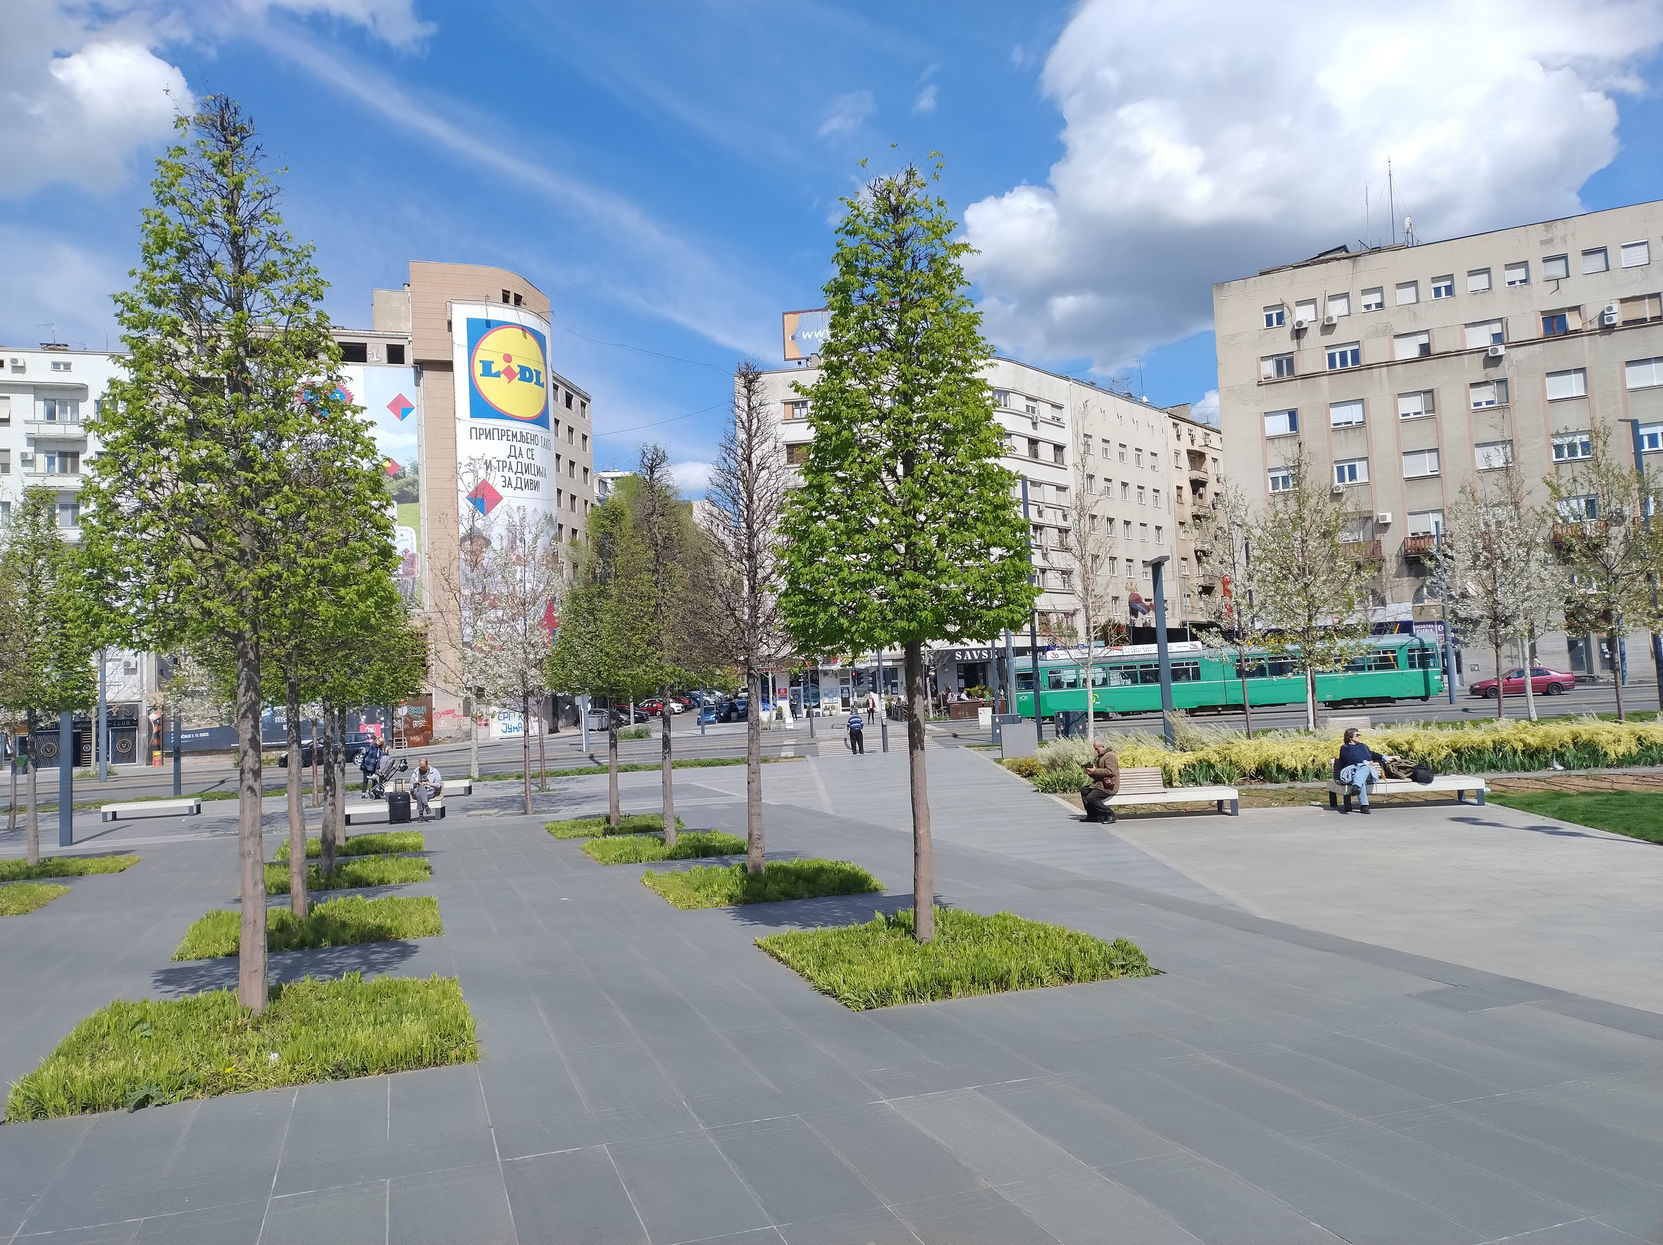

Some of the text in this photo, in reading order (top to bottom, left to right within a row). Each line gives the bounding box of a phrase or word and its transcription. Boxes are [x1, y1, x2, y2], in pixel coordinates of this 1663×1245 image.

[469, 427, 540, 446] ПРИПРЕМЉЕНО
[507, 445, 535, 461] ДА СЕ
[485, 459, 493, 472] И
